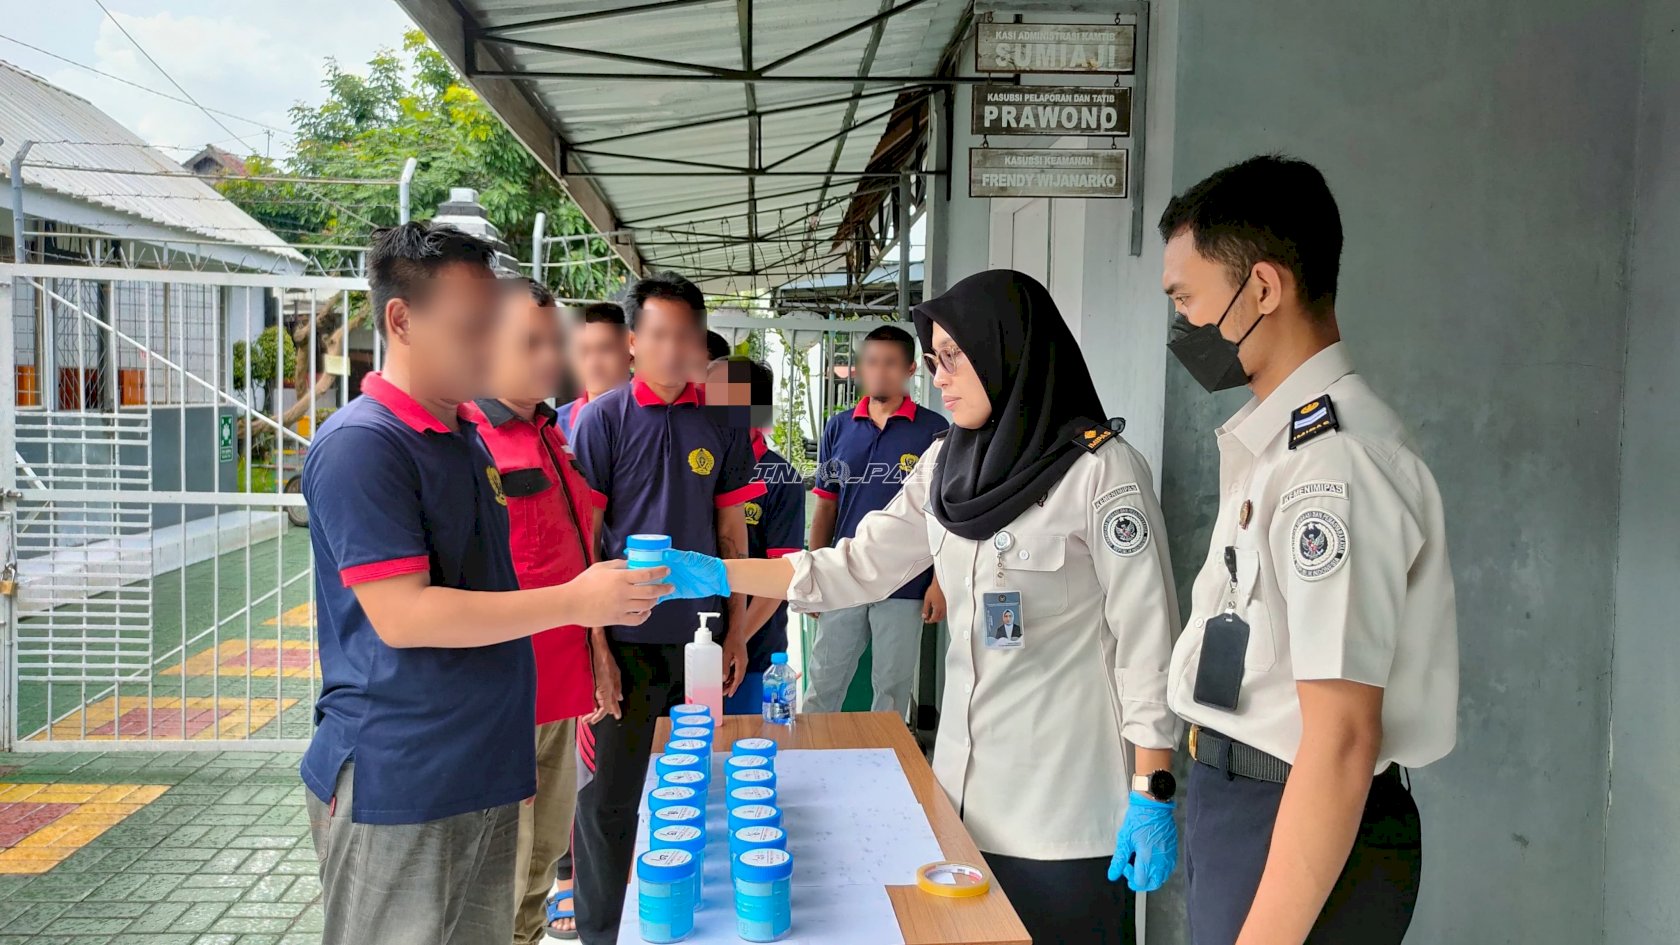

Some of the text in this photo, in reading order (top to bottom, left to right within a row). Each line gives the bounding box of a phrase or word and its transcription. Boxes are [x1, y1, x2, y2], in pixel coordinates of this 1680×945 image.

[995, 31, 1116, 41] KASI ADMINISTRASI KAMTIB
[995, 42, 1116, 67] SUMIAJI
[987, 93, 1115, 103] KASUBSI PELAPORAN DAN TATIB
[984, 105, 1118, 129] PRAWONO
[1004, 155, 1043, 166] KASUBSI
[982, 173, 1117, 188] FRENDY WIJANARKO
